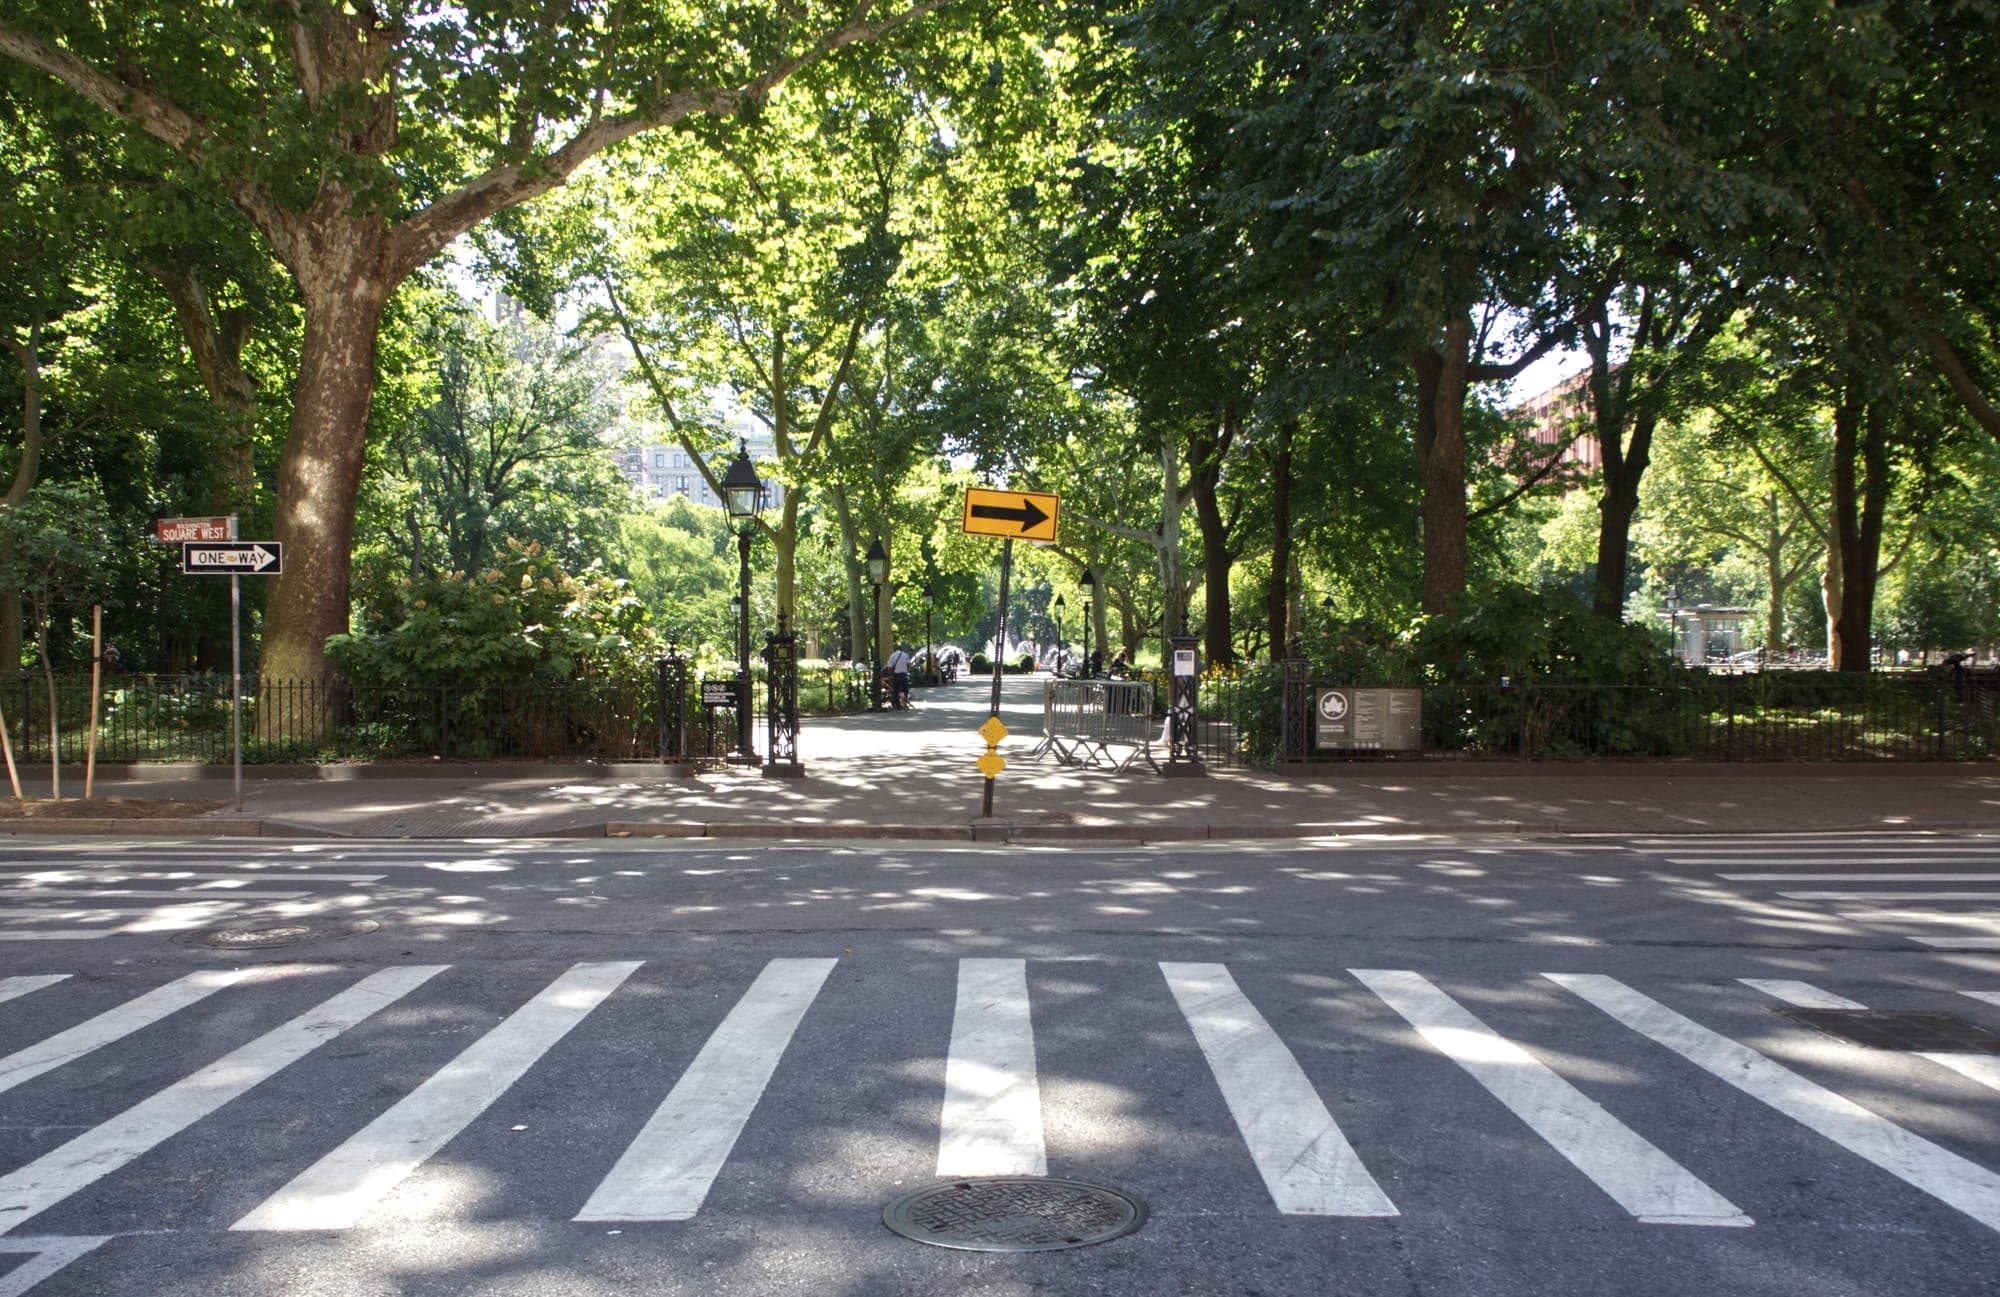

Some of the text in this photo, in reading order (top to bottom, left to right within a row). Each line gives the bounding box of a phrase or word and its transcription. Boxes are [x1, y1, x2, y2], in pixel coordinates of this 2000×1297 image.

[163, 527, 224, 541] SQUARE WEST
[198, 552, 266, 564] ONE WAY
